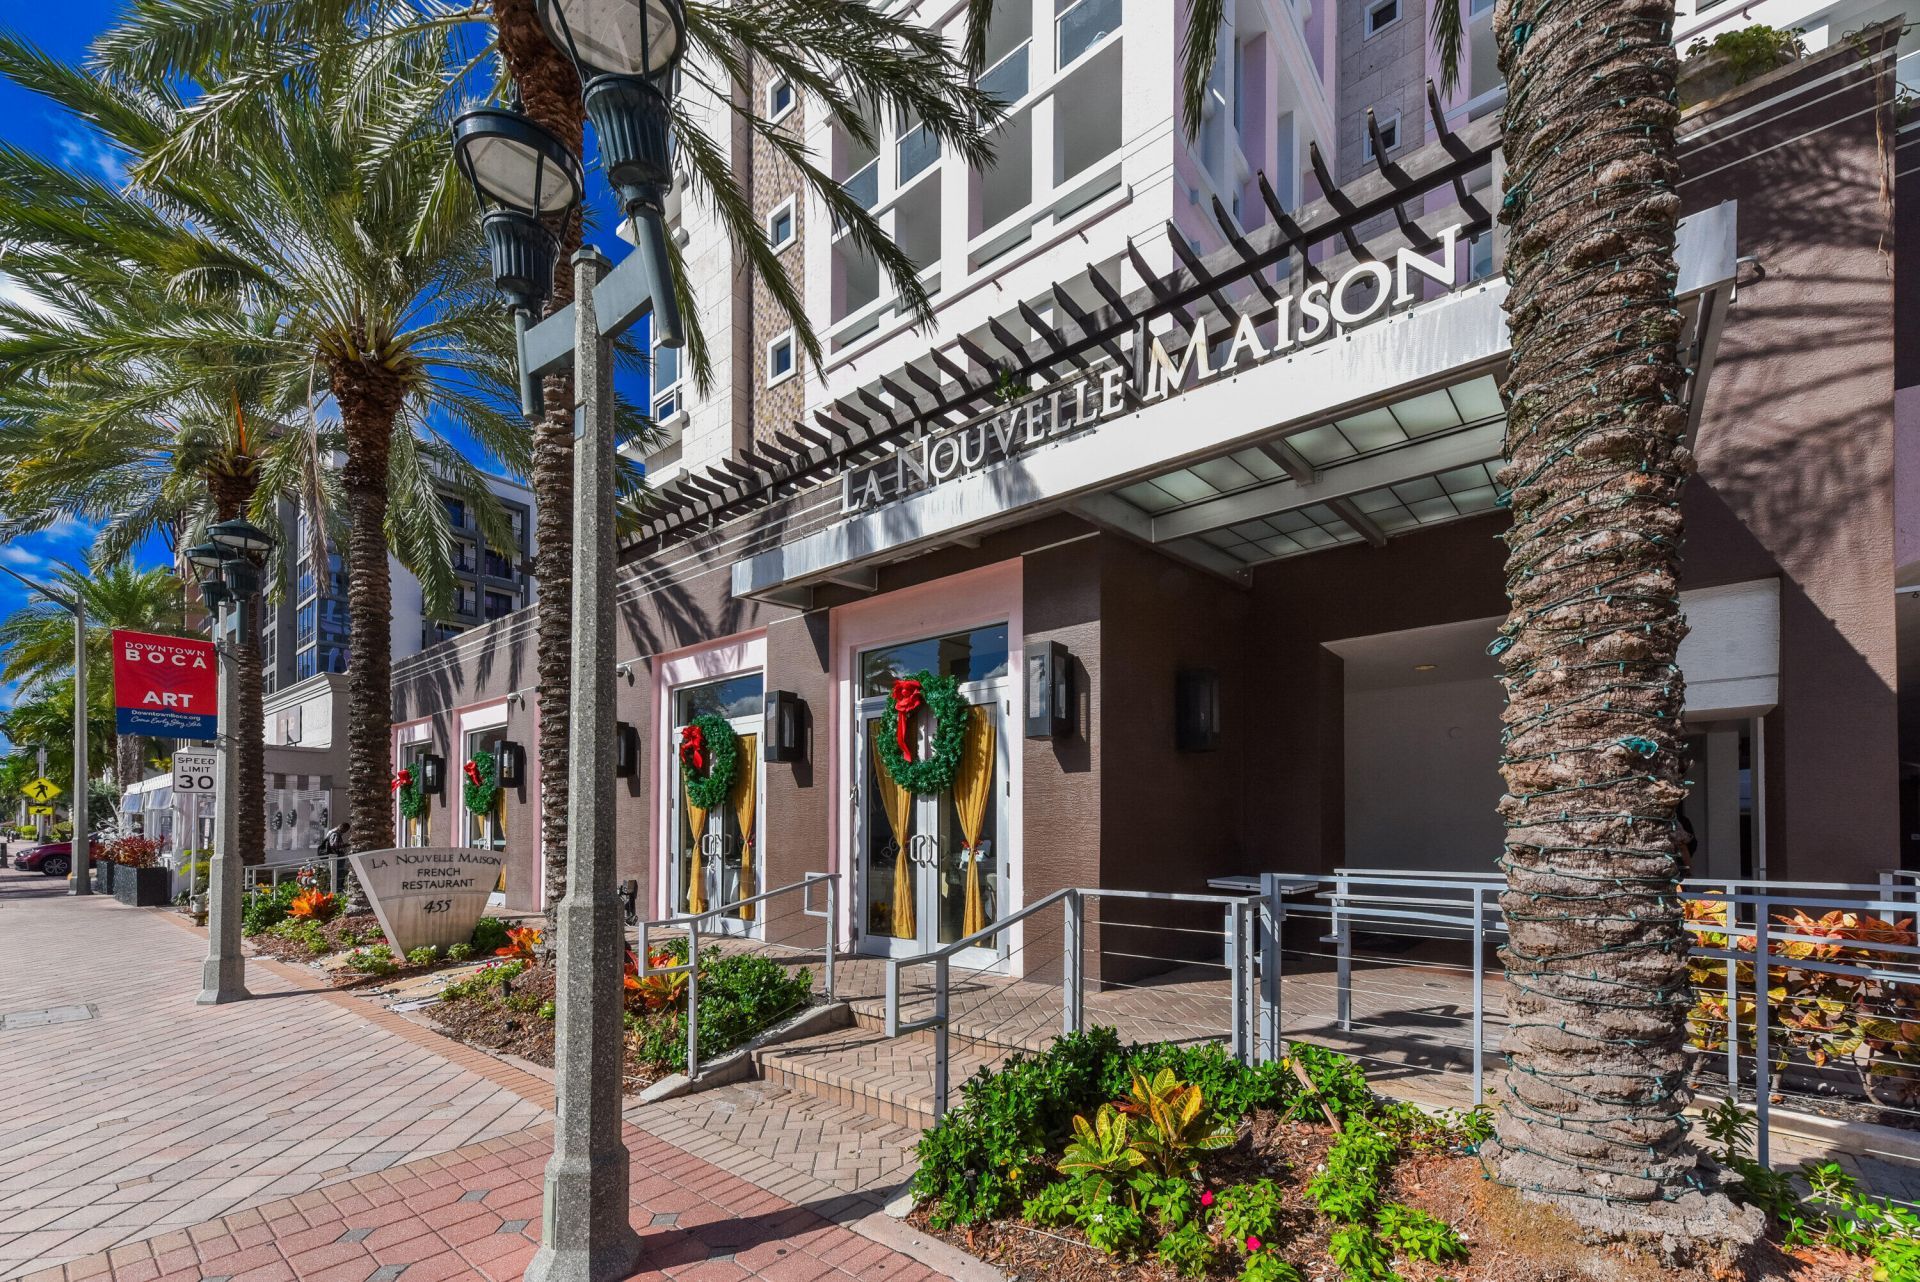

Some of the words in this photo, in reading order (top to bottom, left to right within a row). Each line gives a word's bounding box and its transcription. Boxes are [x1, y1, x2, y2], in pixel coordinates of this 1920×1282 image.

[840, 468, 885, 514] LA
[896, 365, 1125, 495] NOUVELLE
[1142, 224, 1462, 401] MAISON
[125, 641, 205, 657] DOWNTOWN
[125, 649, 207, 669] BOCA
[142, 691, 193, 708] ART
[131, 709, 201, 721] DowntownBoca.org
[177, 757, 216, 765] SPEED
[178, 774, 215, 790] 30
[371, 858, 389, 870] LA
[395, 853, 454, 866] NOUVELLE
[458, 853, 502, 866] MAISON
[417, 867, 461, 877] FRENCH
[402, 878, 475, 890] RESTAURANT
[423, 899, 453, 914] 455
